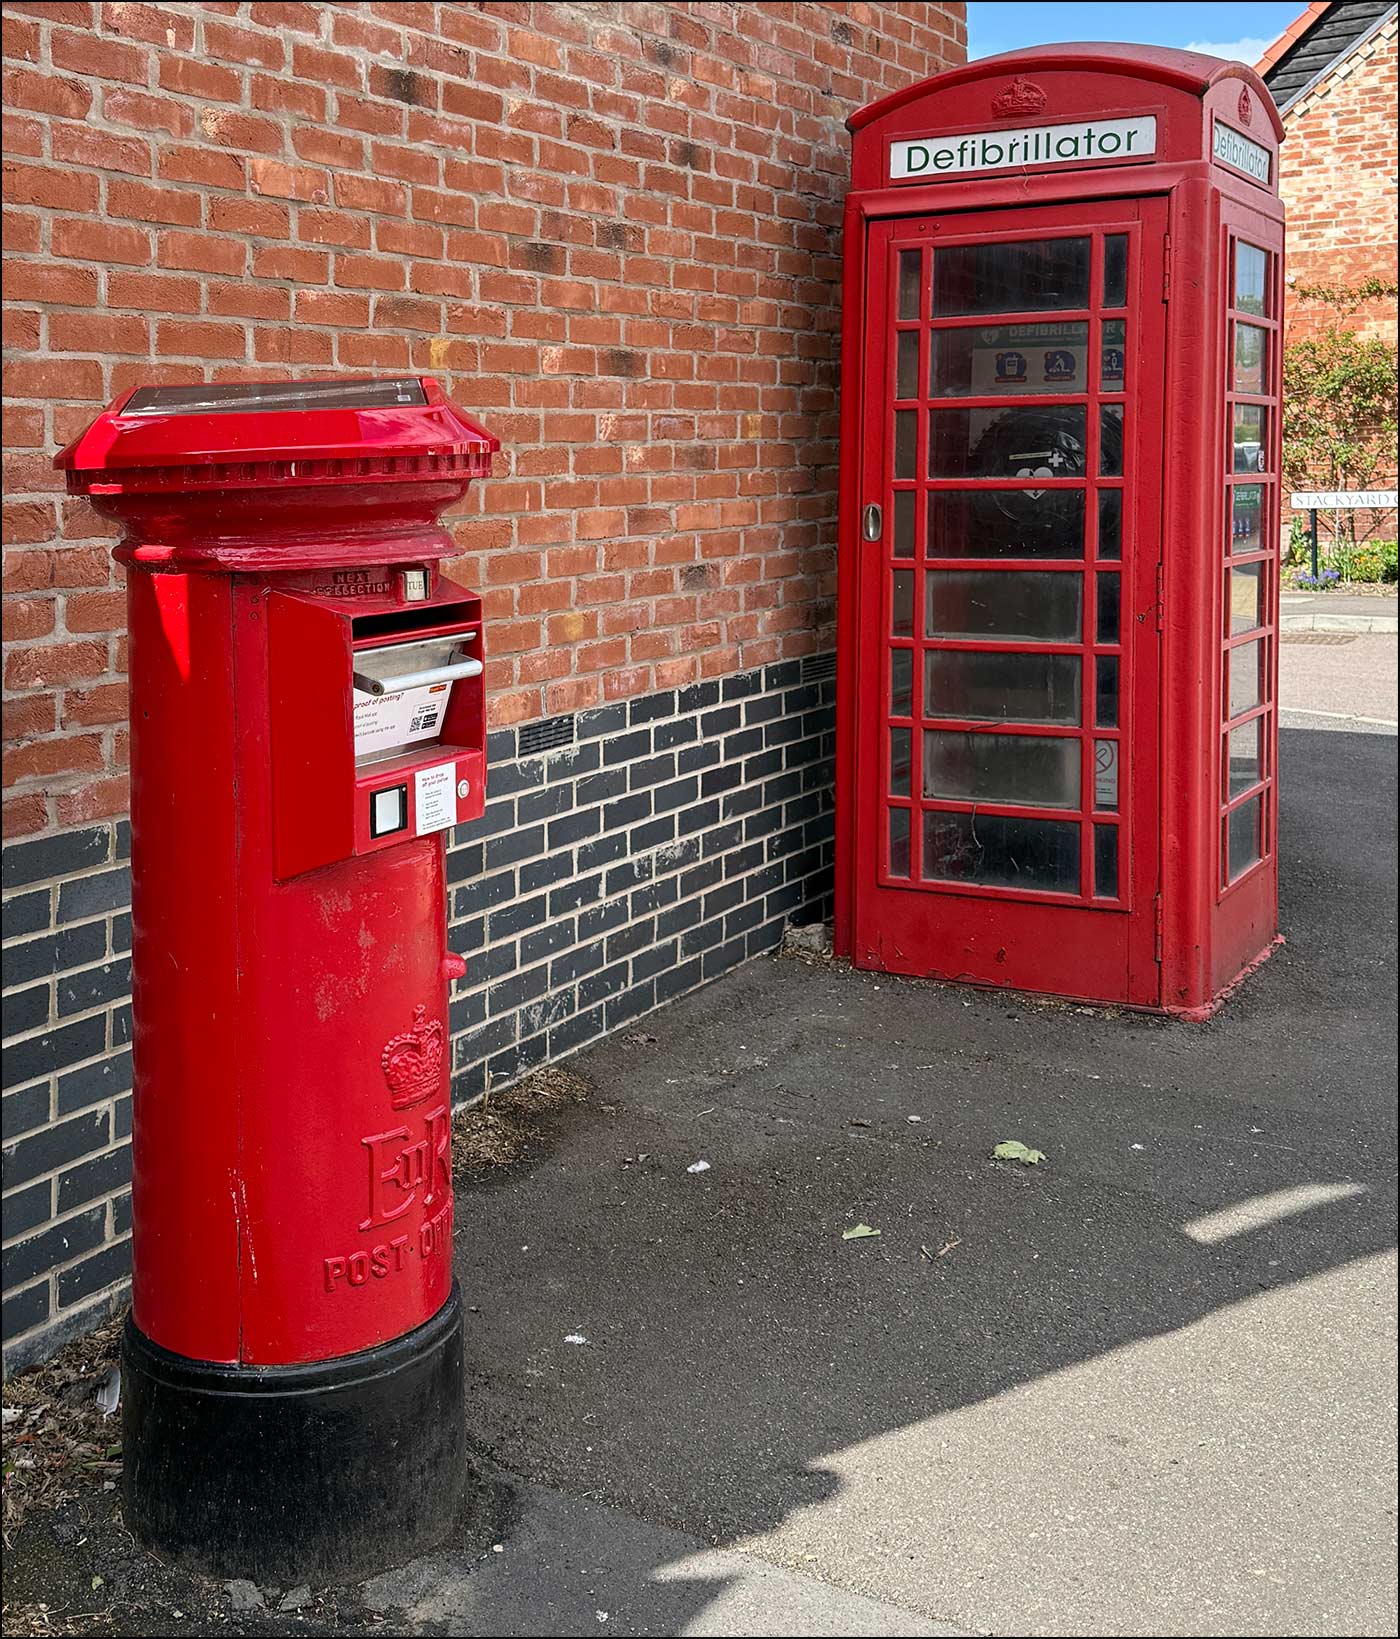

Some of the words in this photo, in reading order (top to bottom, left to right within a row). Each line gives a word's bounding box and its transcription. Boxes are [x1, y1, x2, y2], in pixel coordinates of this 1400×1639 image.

[906, 128, 1138, 173] Defibrillator
[1214, 125, 1266, 178] Defibrillator
[1296, 493, 1389, 506] STACKYARD
[337, 571, 370, 583] NEXT
[317, 583, 390, 596] COLLECTION
[408, 581, 424, 590] TUE
[324, 1234, 409, 1292] POST
